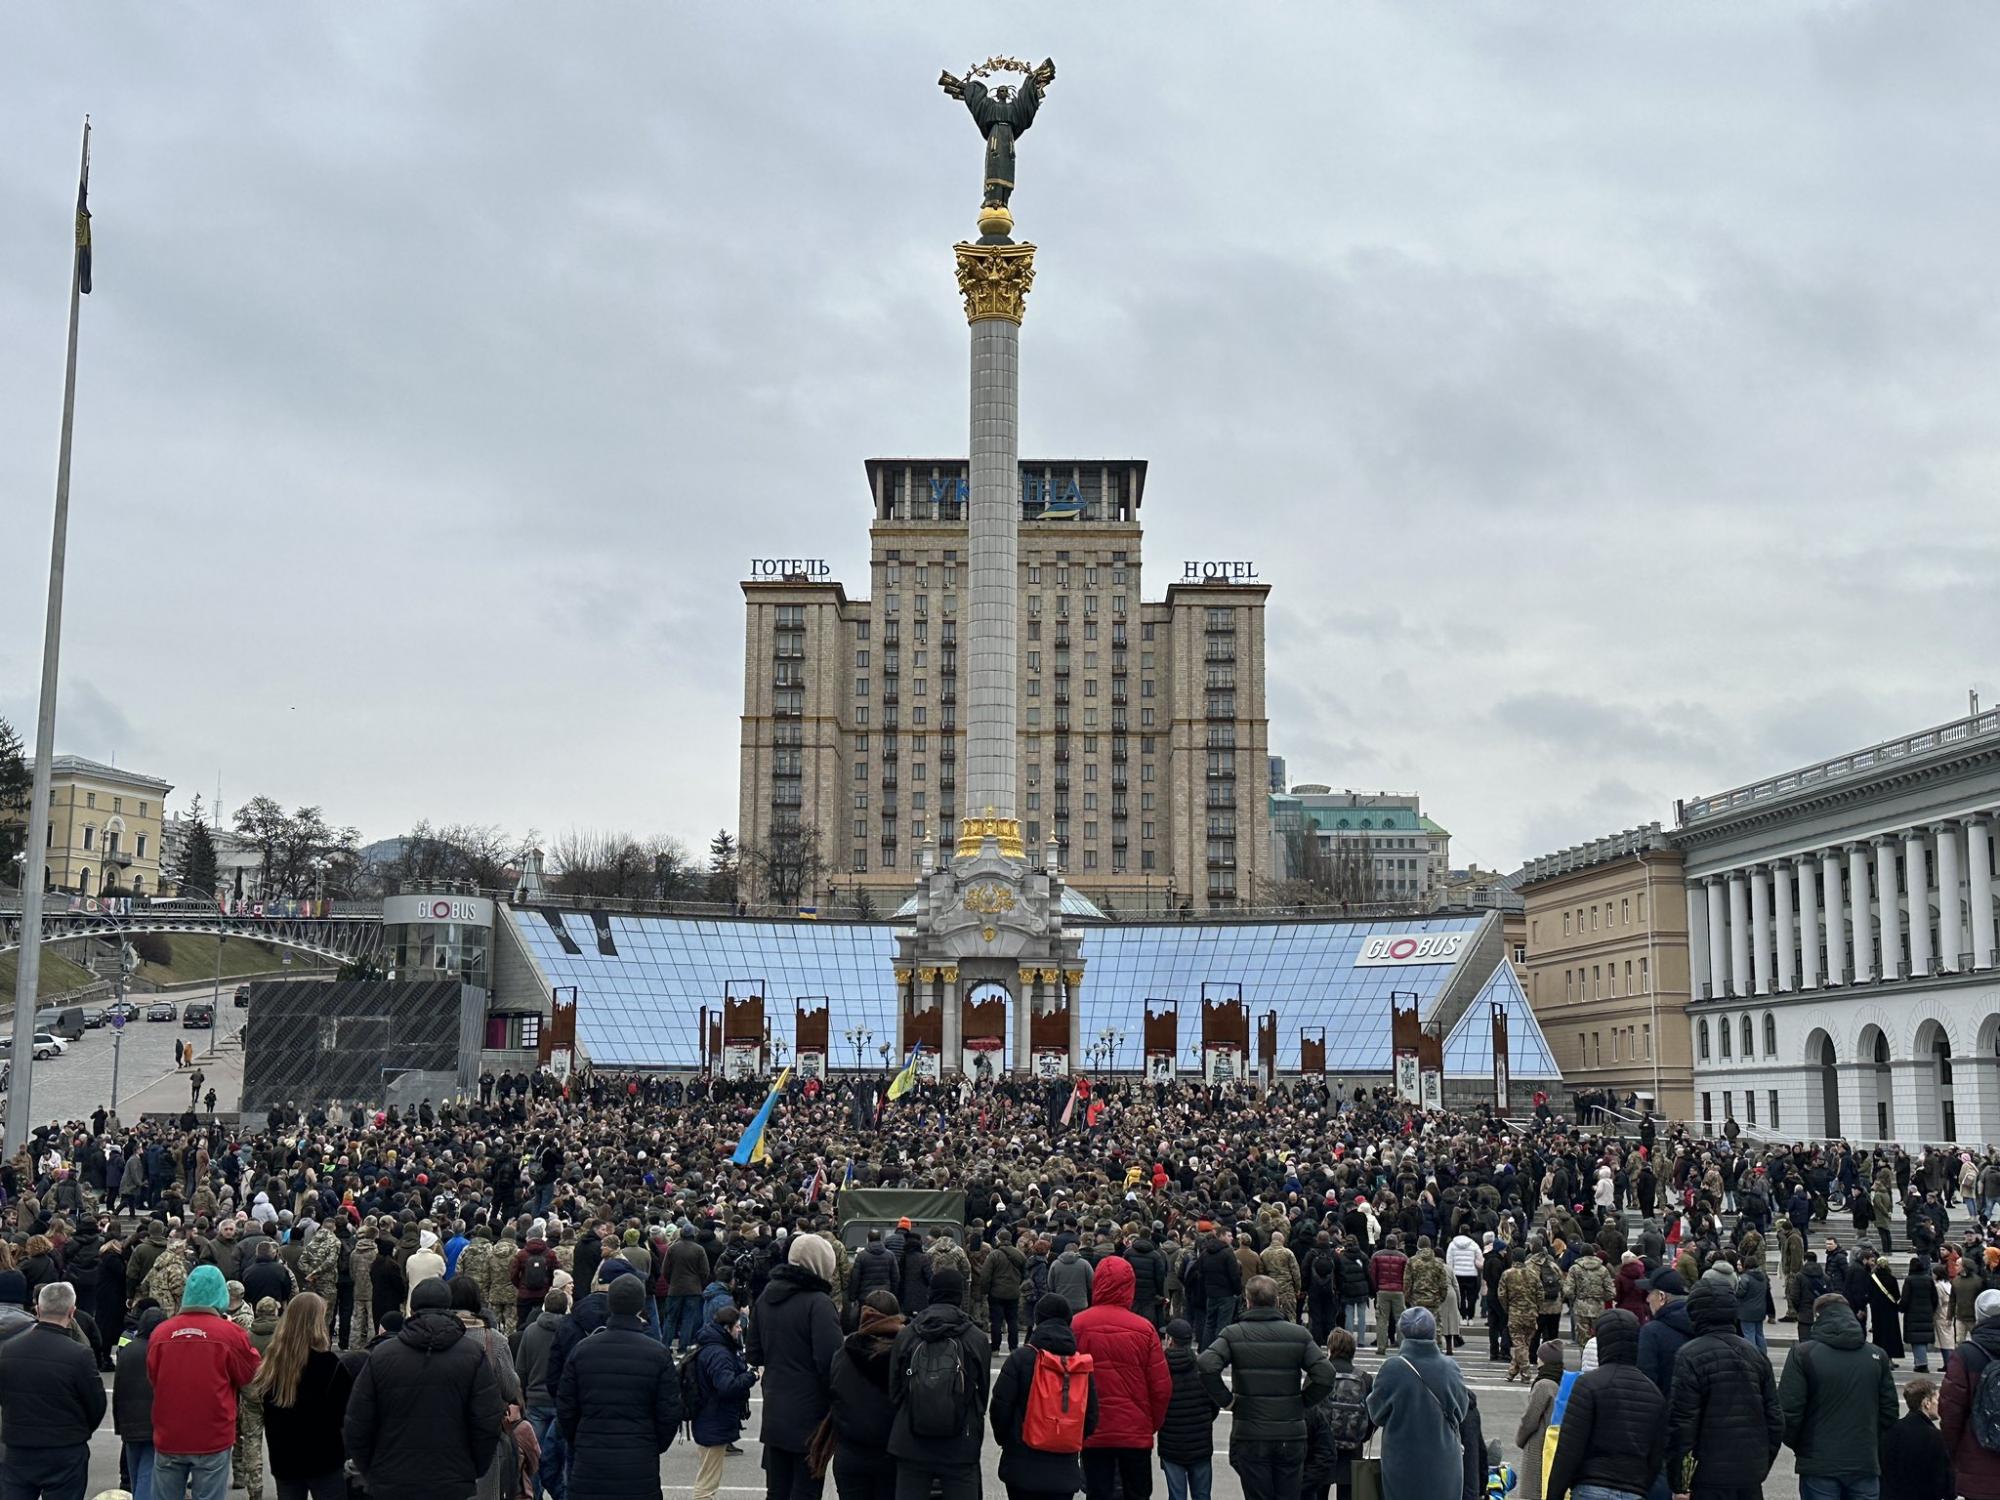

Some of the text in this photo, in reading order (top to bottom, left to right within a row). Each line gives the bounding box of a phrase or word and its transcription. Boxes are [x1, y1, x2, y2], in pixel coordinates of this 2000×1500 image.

[928, 474, 1085, 502] УКЇНА
[751, 559, 830, 575] ГОТЕЛЬ
[1184, 561, 1259, 577] HOTEL
[418, 901, 477, 920] GLOBUS
[1367, 935, 1461, 959] GLOBUS
